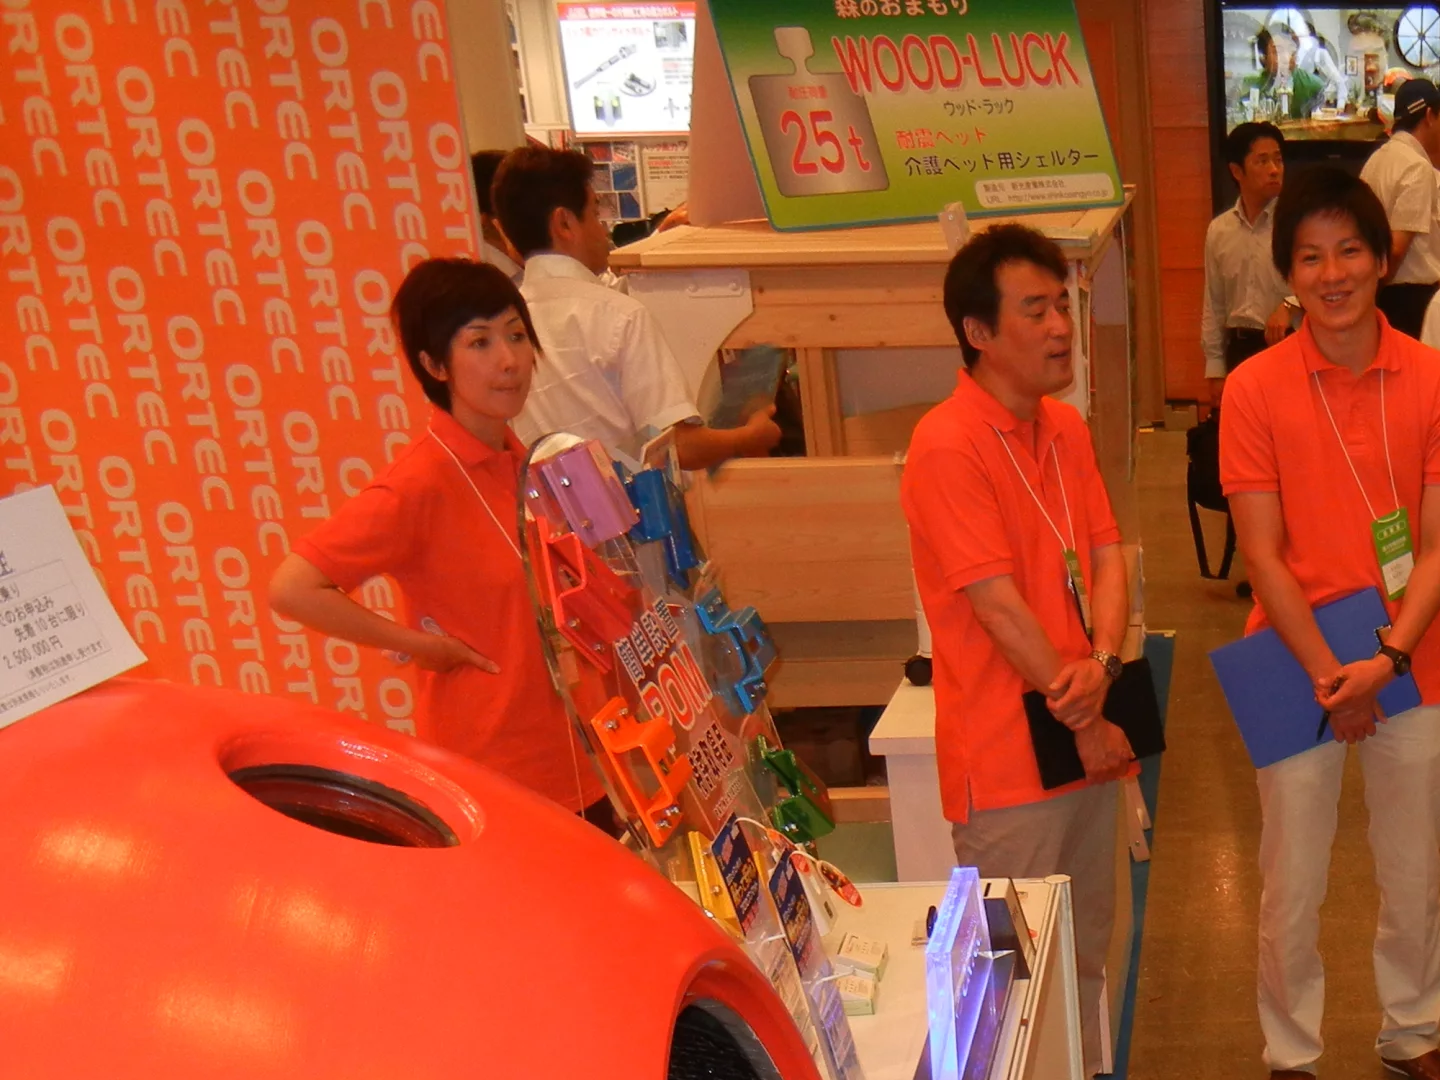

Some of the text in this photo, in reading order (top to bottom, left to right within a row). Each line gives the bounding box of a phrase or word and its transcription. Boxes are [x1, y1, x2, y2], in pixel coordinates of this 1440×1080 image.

[2, 0, 67, 175] RTEC
[55, 14, 128, 226] ORTEC
[310, 18, 376, 230] ORTEC
[831, 31, 1081, 96] WOOD-LUCK
[942, 98, 1016, 119] ウッド・ラック
[0, 167, 59, 370] ORTEC
[117, 66, 187, 276] ORTEC
[178, 119, 246, 325] ORTEC
[47, 217, 119, 418] ORTEC
[108, 266, 177, 465] ORTEC
[237, 170, 303, 373] ORTEC
[296, 220, 360, 420] ORTEC
[167, 315, 235, 510] ORTEC
[226, 364, 290, 556] ORTEC
[99, 455, 166, 643] ORTEC
[157, 502, 222, 685] ORTEC
